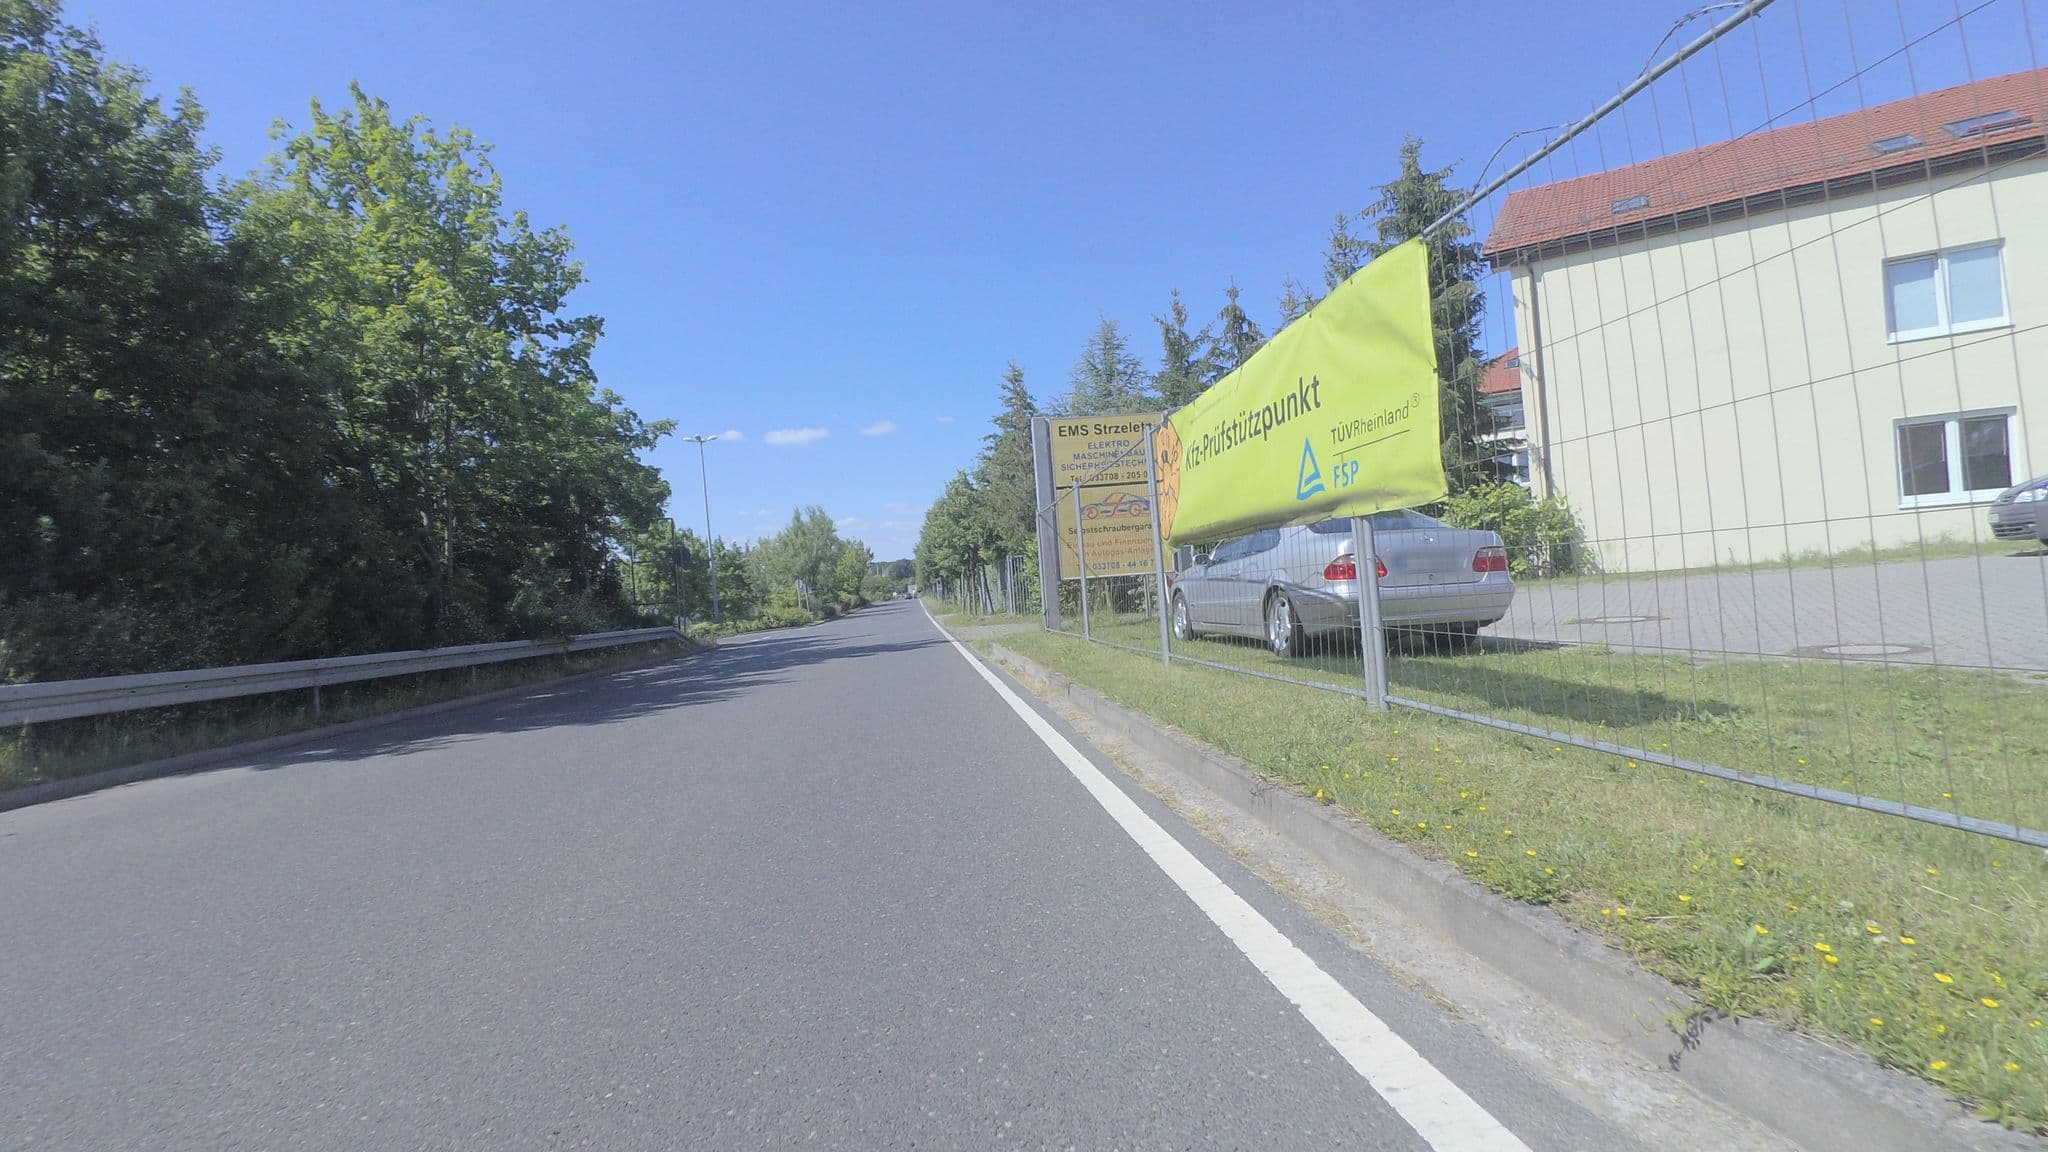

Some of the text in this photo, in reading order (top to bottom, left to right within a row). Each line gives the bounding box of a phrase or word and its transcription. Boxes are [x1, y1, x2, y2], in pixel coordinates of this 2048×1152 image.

[1058, 424, 1089, 438] EMS
[1185, 374, 1321, 472] Kfz-Prüfstützpunkt
[1087, 440, 1130, 450] ELEKTRO
[1333, 460, 1360, 488] FSP
